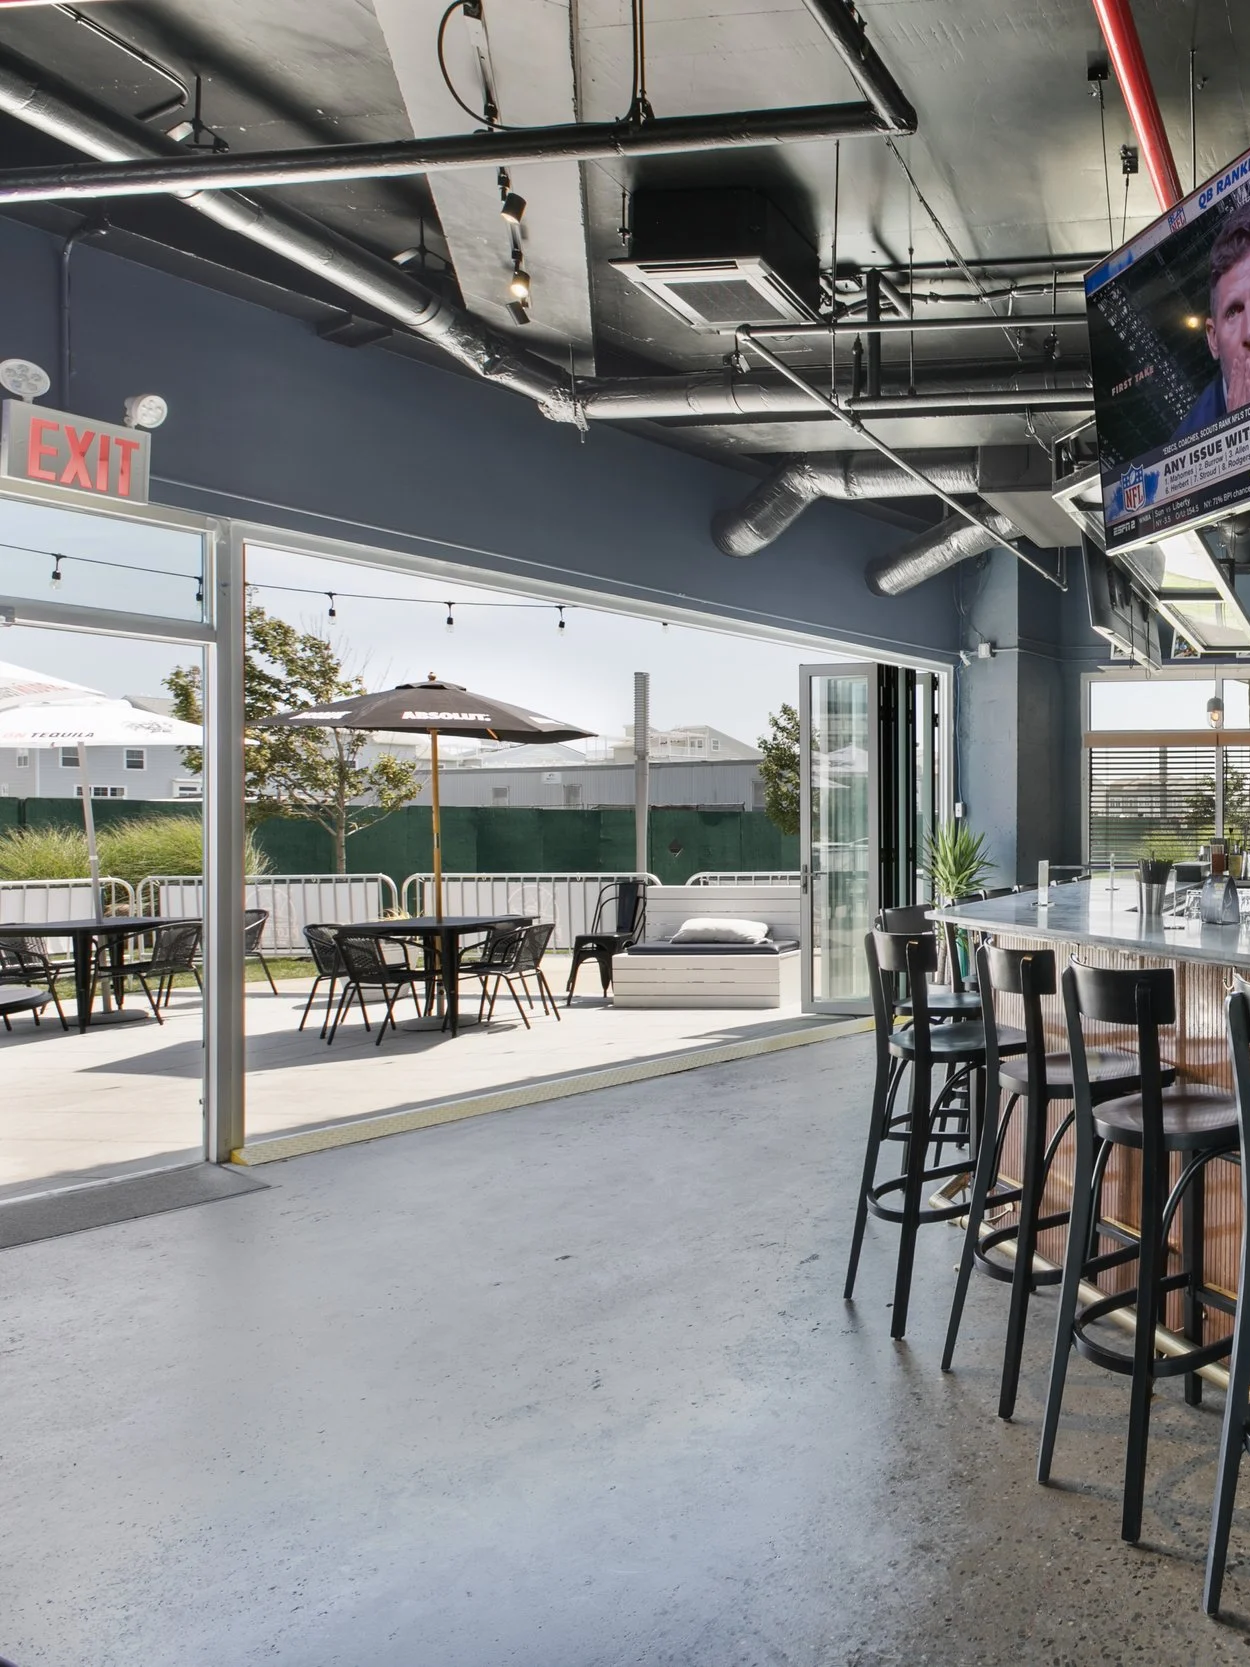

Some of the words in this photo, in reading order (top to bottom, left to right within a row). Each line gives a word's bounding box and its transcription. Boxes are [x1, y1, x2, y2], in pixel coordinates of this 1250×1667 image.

[1198, 187, 1213, 210] QB
[1111, 377, 1133, 397] FIRST
[1134, 365, 1154, 383] TAKE
[1200, 423, 1218, 437] SCOUTS
[1218, 417, 1232, 429] RANK
[27, 416, 140, 497] EXIT
[1164, 455, 1186, 476] ANY
[1189, 439, 1223, 465] ISSUE
[1170, 467, 1194, 482] Mahomes
[1204, 455, 1224, 468] Burrow
[1234, 444, 1250, 455] Allen
[1170, 479, 1189, 492] Herbert
[1199, 467, 1217, 480] Stroud
[1125, 484, 1144, 509] NFL
[1154, 509, 1165, 518] Sun
[1172, 498, 1191, 510] Liberty
[1155, 519, 1162, 527] NY
[1223, 492, 1233, 502] BPI
[1232, 485, 1250, 498] chance
